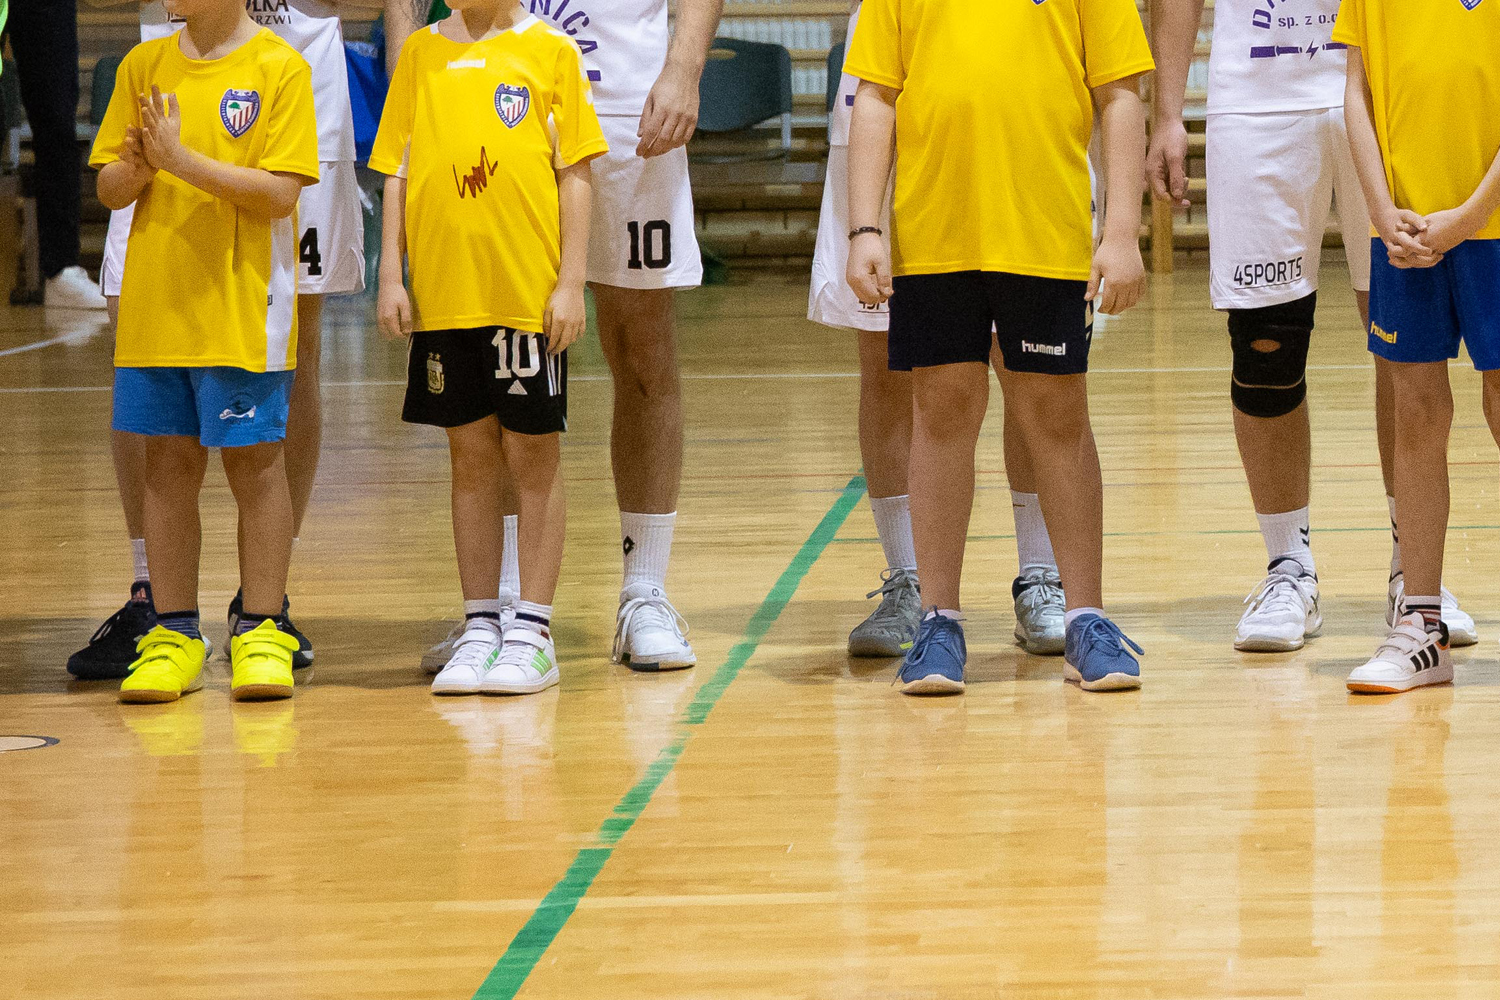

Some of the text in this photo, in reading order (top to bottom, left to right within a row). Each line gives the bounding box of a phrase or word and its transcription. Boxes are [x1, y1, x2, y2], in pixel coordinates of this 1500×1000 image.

[251, 14, 292, 25] RZWI
[1278, 17, 1299, 29] sp.
[1305, 16, 1312, 25] z
[627, 219, 671, 269] 10
[1234, 256, 1303, 286] 4SPORTS
[491, 328, 540, 379] 10
[1021, 339, 1066, 356] hummel
